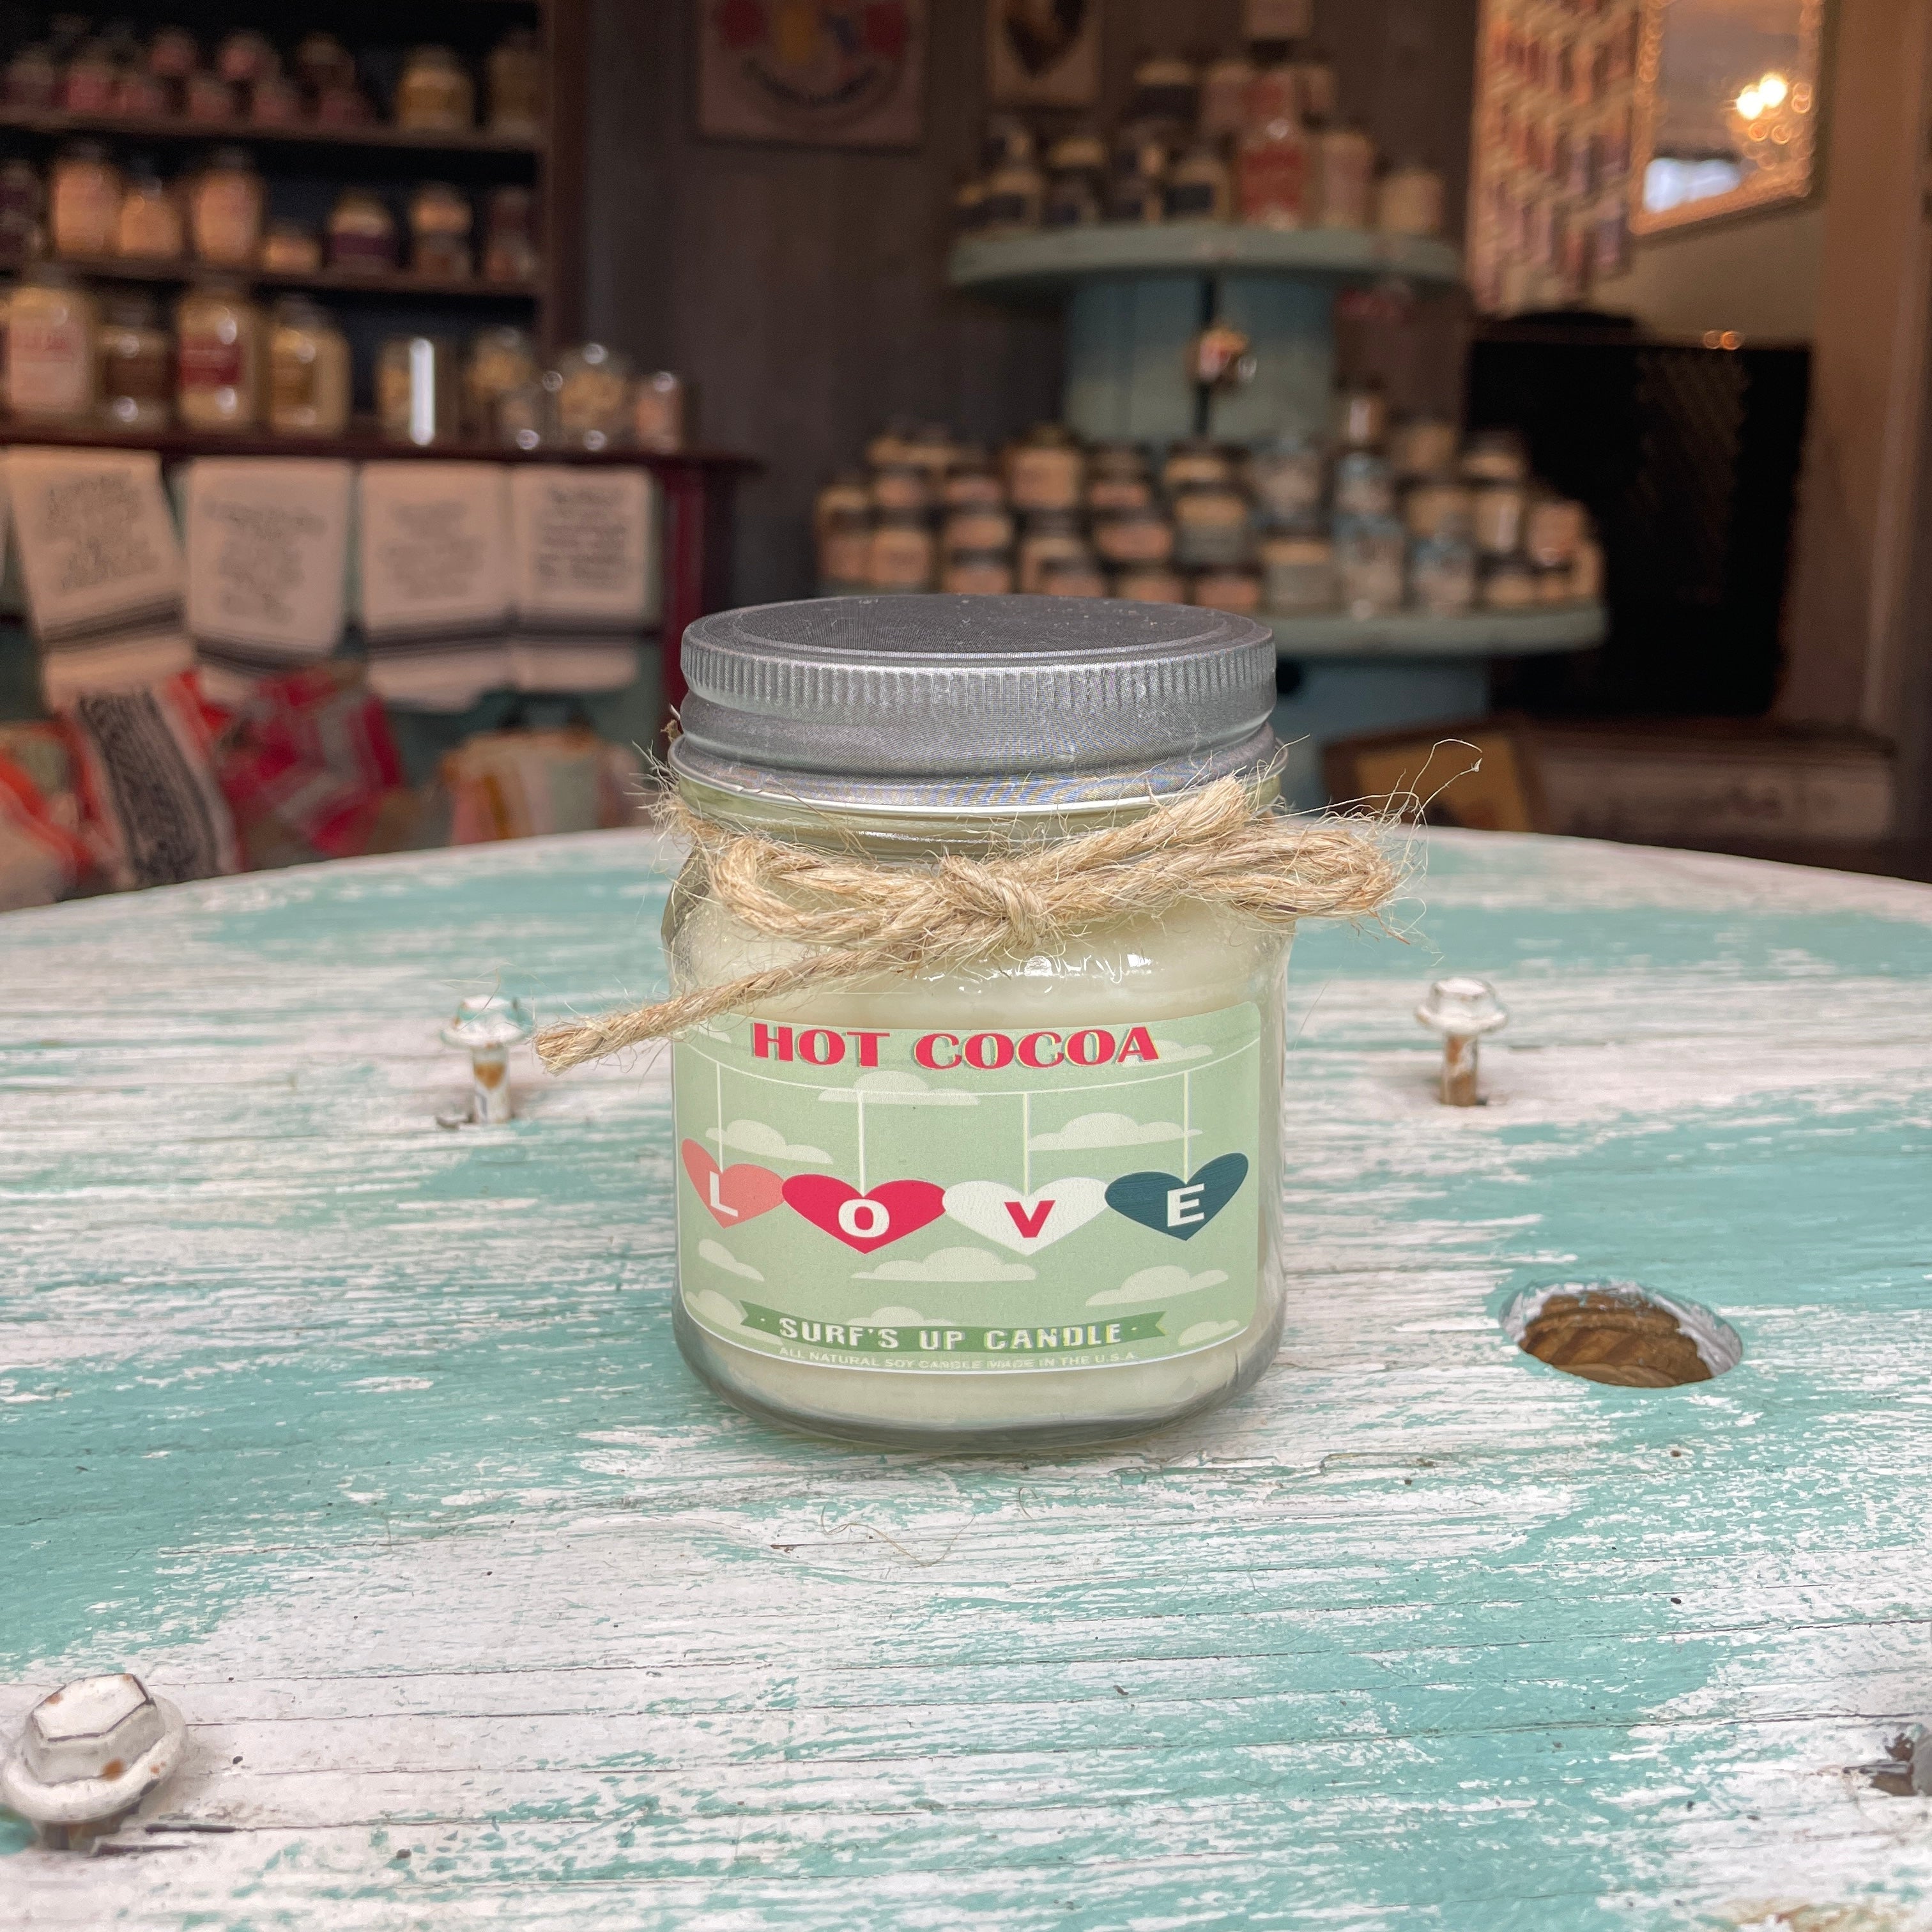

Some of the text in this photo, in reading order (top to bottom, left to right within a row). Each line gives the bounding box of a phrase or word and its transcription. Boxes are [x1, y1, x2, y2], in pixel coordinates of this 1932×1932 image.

[752, 1022, 1160, 1070] HOT COCOA
[778, 1317, 1121, 1351] SURF'S UP CANDLE
[779, 1347, 805, 1359] ALL
[809, 1351, 880, 1367] NATURAL
[884, 1358, 914, 1368] SOY
[919, 1360, 983, 1369] CANDLE
[986, 1359, 1035, 1369] MADE
[1038, 1357, 1055, 1367] IN
[1061, 1355, 1089, 1366] THE
